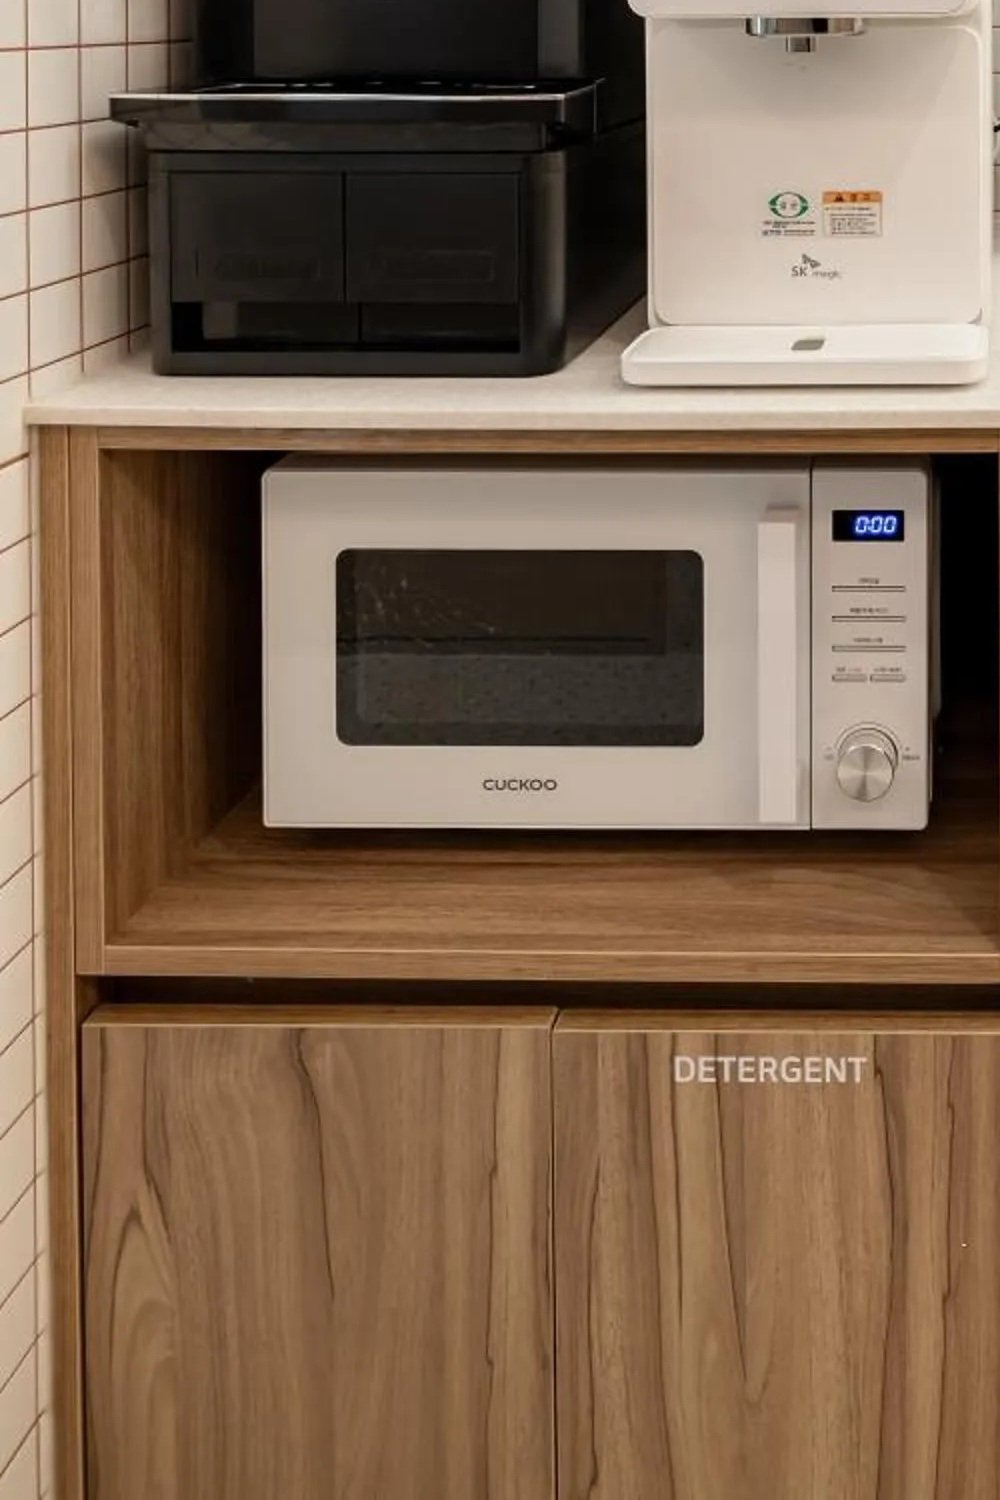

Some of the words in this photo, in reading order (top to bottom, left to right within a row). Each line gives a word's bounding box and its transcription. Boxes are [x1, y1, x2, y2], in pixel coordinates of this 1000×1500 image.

[791, 265, 808, 277] SK
[482, 779, 558, 791] CUCKOO
[673, 1055, 868, 1084] DETERGENT
